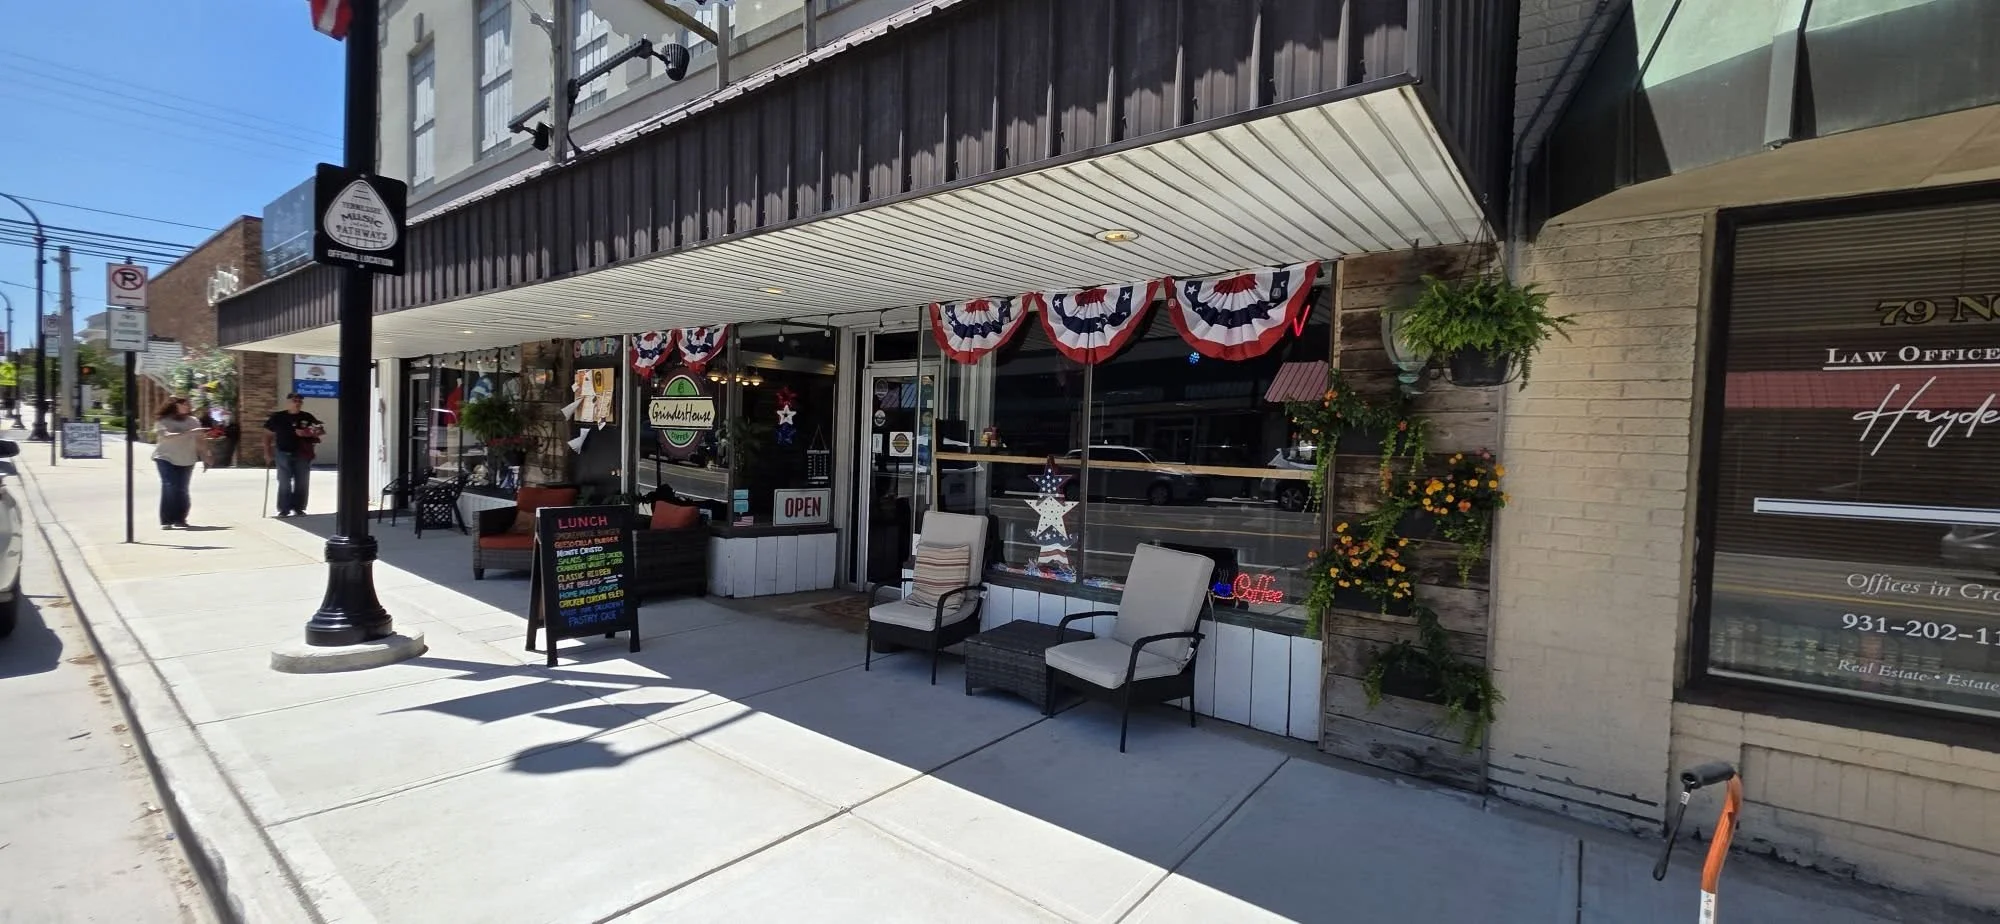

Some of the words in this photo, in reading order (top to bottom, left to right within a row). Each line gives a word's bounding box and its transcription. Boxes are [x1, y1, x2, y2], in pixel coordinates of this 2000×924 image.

[341, 213, 384, 228] MUSIC
[336, 224, 388, 241] PATHWAYS
[1876, 300, 1938, 326] 79
[652, 402, 711, 423] GrinderHouse
[670, 432, 689, 441] COFFEE
[784, 496, 822, 518] OPEN
[558, 515, 608, 529] LUNCH
[556, 548, 579, 557] MONTE
[580, 546, 603, 555] CRISTO
[557, 572, 585, 583] CLASSIC
[586, 568, 612, 578] REUBEN
[558, 582, 575, 591] FLAT
[558, 590, 578, 599] HOME
[598, 583, 619, 593] SOUPS
[1233, 573, 1284, 605] Coffee
[1846, 572, 1921, 596] Offices
[1929, 581, 1951, 597] in
[559, 598, 585, 608] CHICKEN
[1838, 659, 1874, 674] Real
[1946, 674, 2000, 692] Estate
